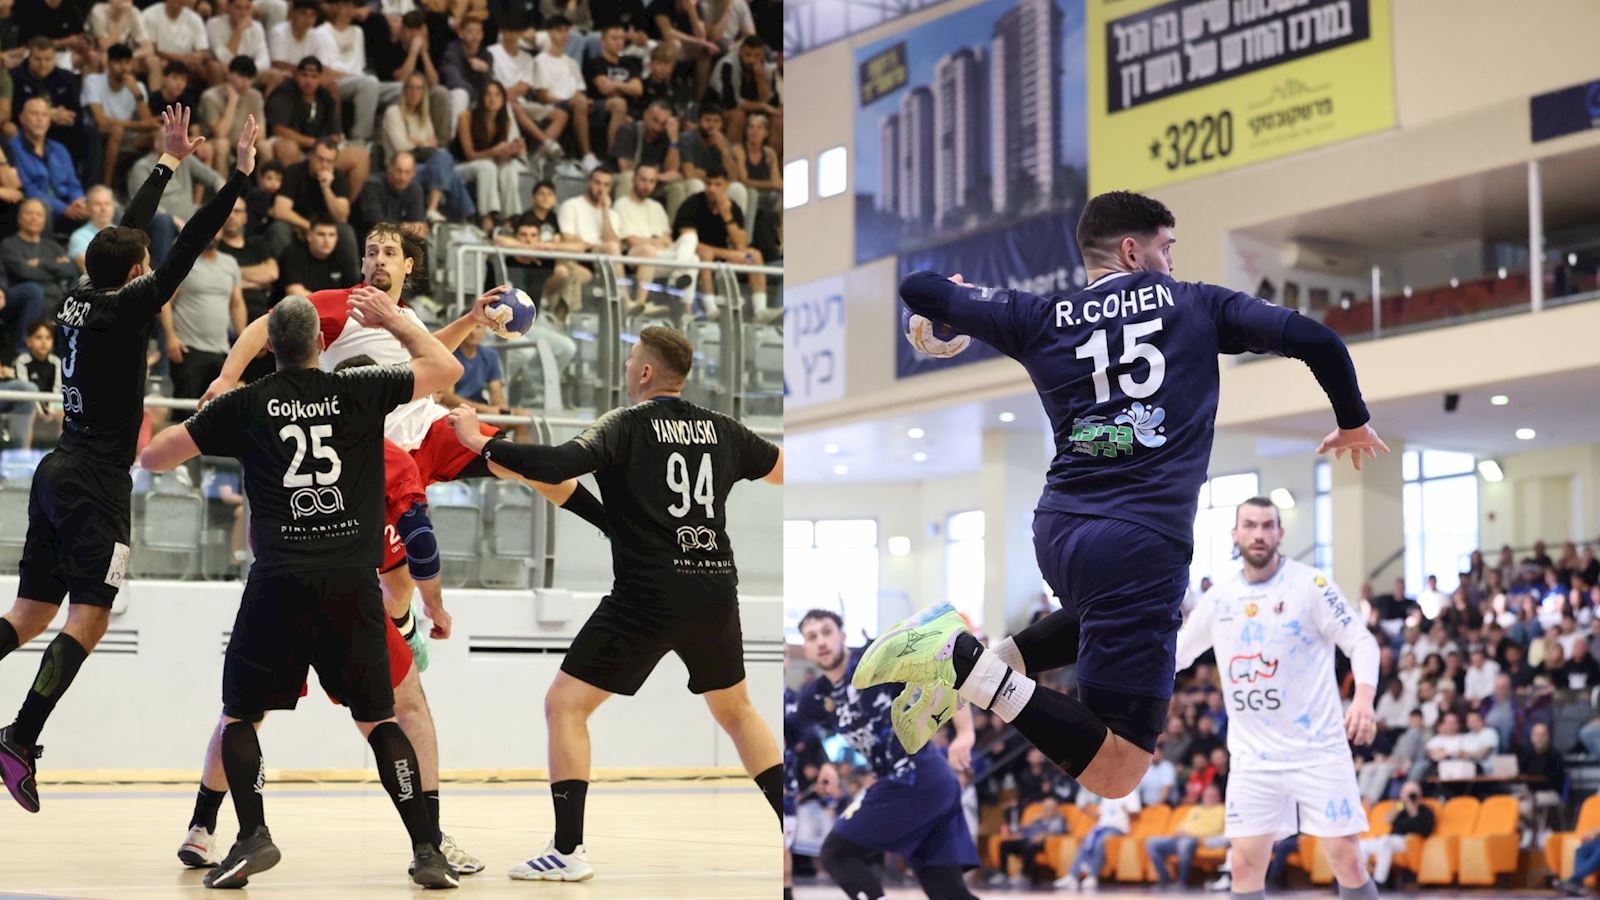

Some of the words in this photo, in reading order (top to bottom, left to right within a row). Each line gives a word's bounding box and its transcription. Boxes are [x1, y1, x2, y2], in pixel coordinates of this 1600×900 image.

[1221, 19, 1283, 71] החדש
[1286, 0, 1352, 51] במרכז
[1144, 50, 1183, 94] גוש
[1184, 39, 1218, 81] של
[1121, 62, 1141, 108] דן
[1055, 284, 1175, 327] R.COHEN
[1075, 317, 1166, 404] 15
[267, 395, 341, 421] Gojković
[279, 424, 342, 487] 25
[666, 452, 715, 518] 94
[1322, 587, 1352, 627] VARTA
[1240, 621, 1264, 643] 44
[1233, 689, 1281, 711] SGS
[394, 758, 415, 802] Kempa
[1325, 798, 1352, 821] 44
